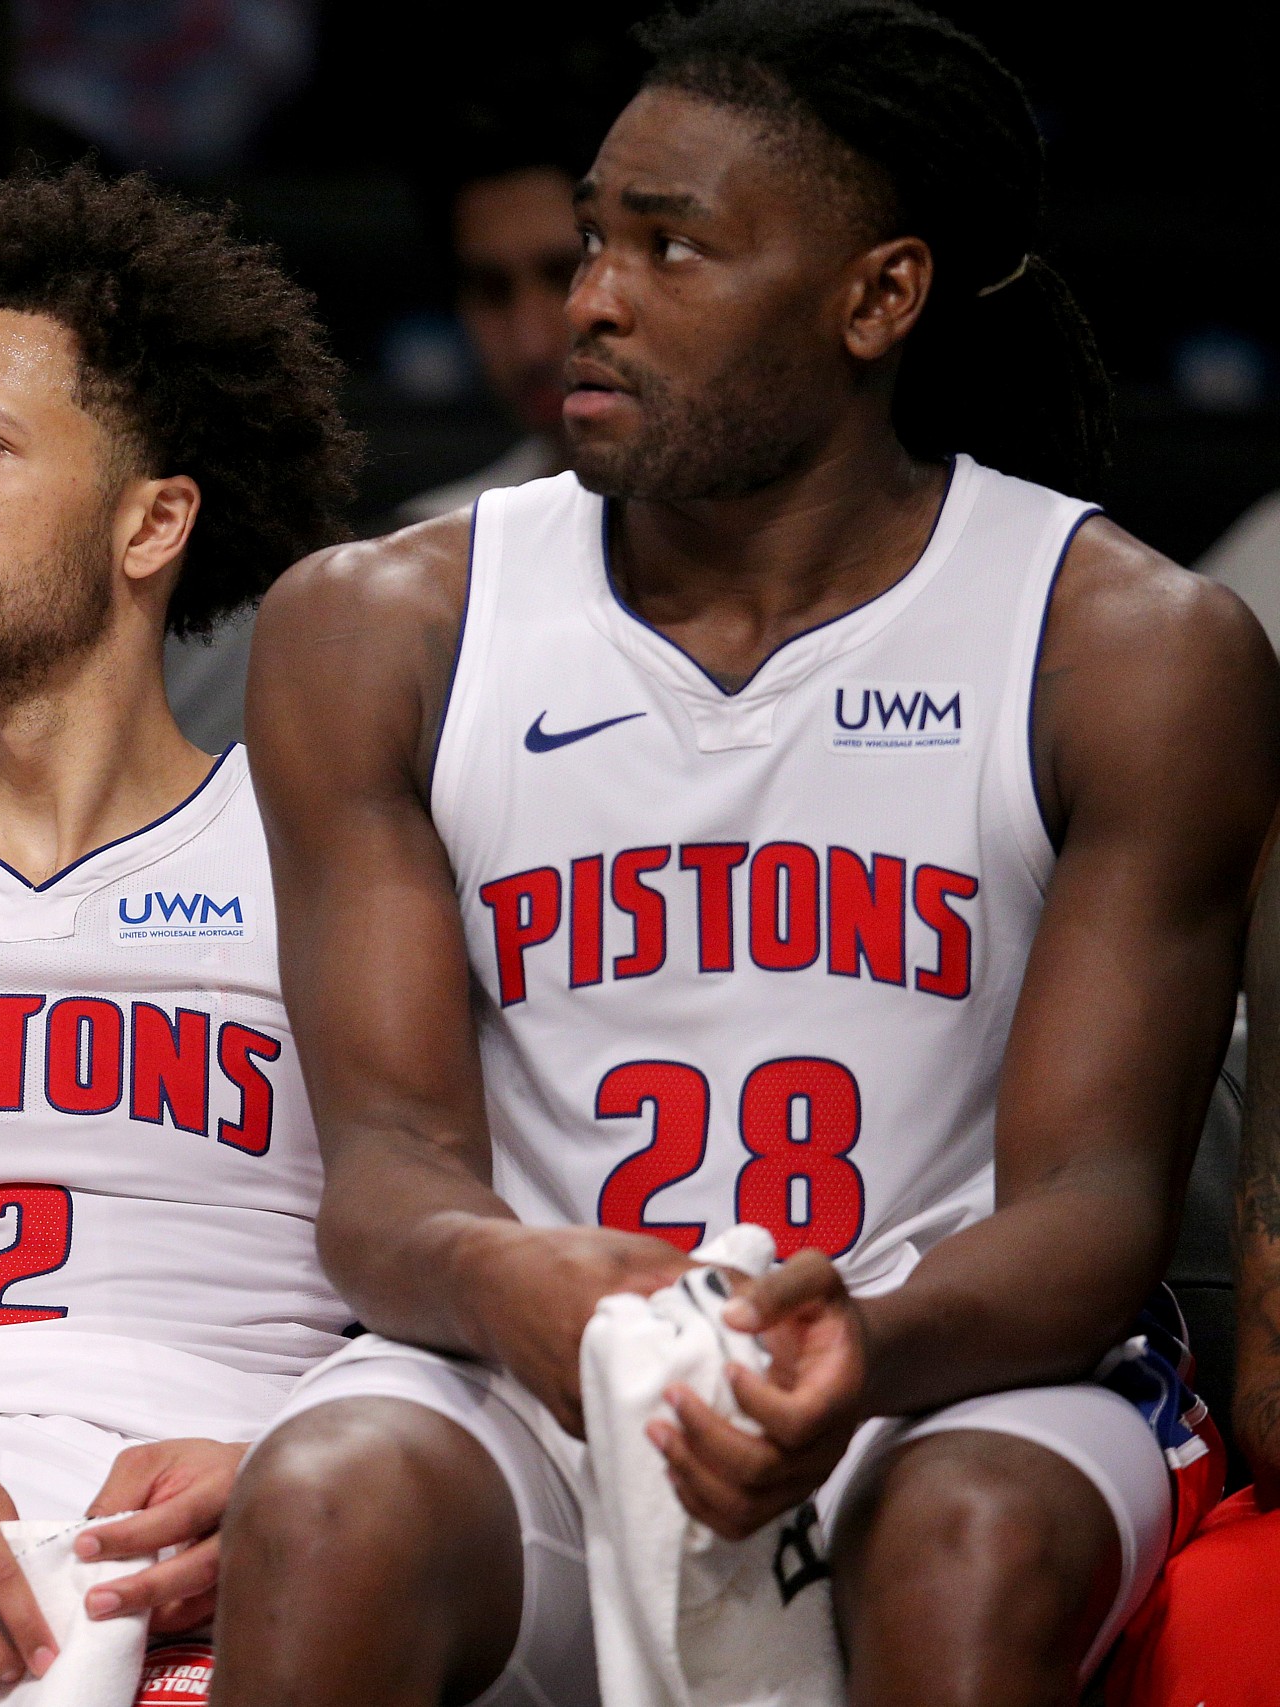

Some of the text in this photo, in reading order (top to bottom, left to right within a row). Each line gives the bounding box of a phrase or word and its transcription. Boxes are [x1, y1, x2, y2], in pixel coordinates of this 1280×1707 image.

[836, 688, 961, 731] UWM
[119, 891, 243, 924] UWM
[119, 929, 245, 939] UNITED WHOLESALE MORTGAGE
[480, 841, 979, 1010] PISTONS
[595, 1056, 865, 1264] 28
[143, 1677, 210, 1696] ISTON
[144, 1664, 215, 1681] ETROI
